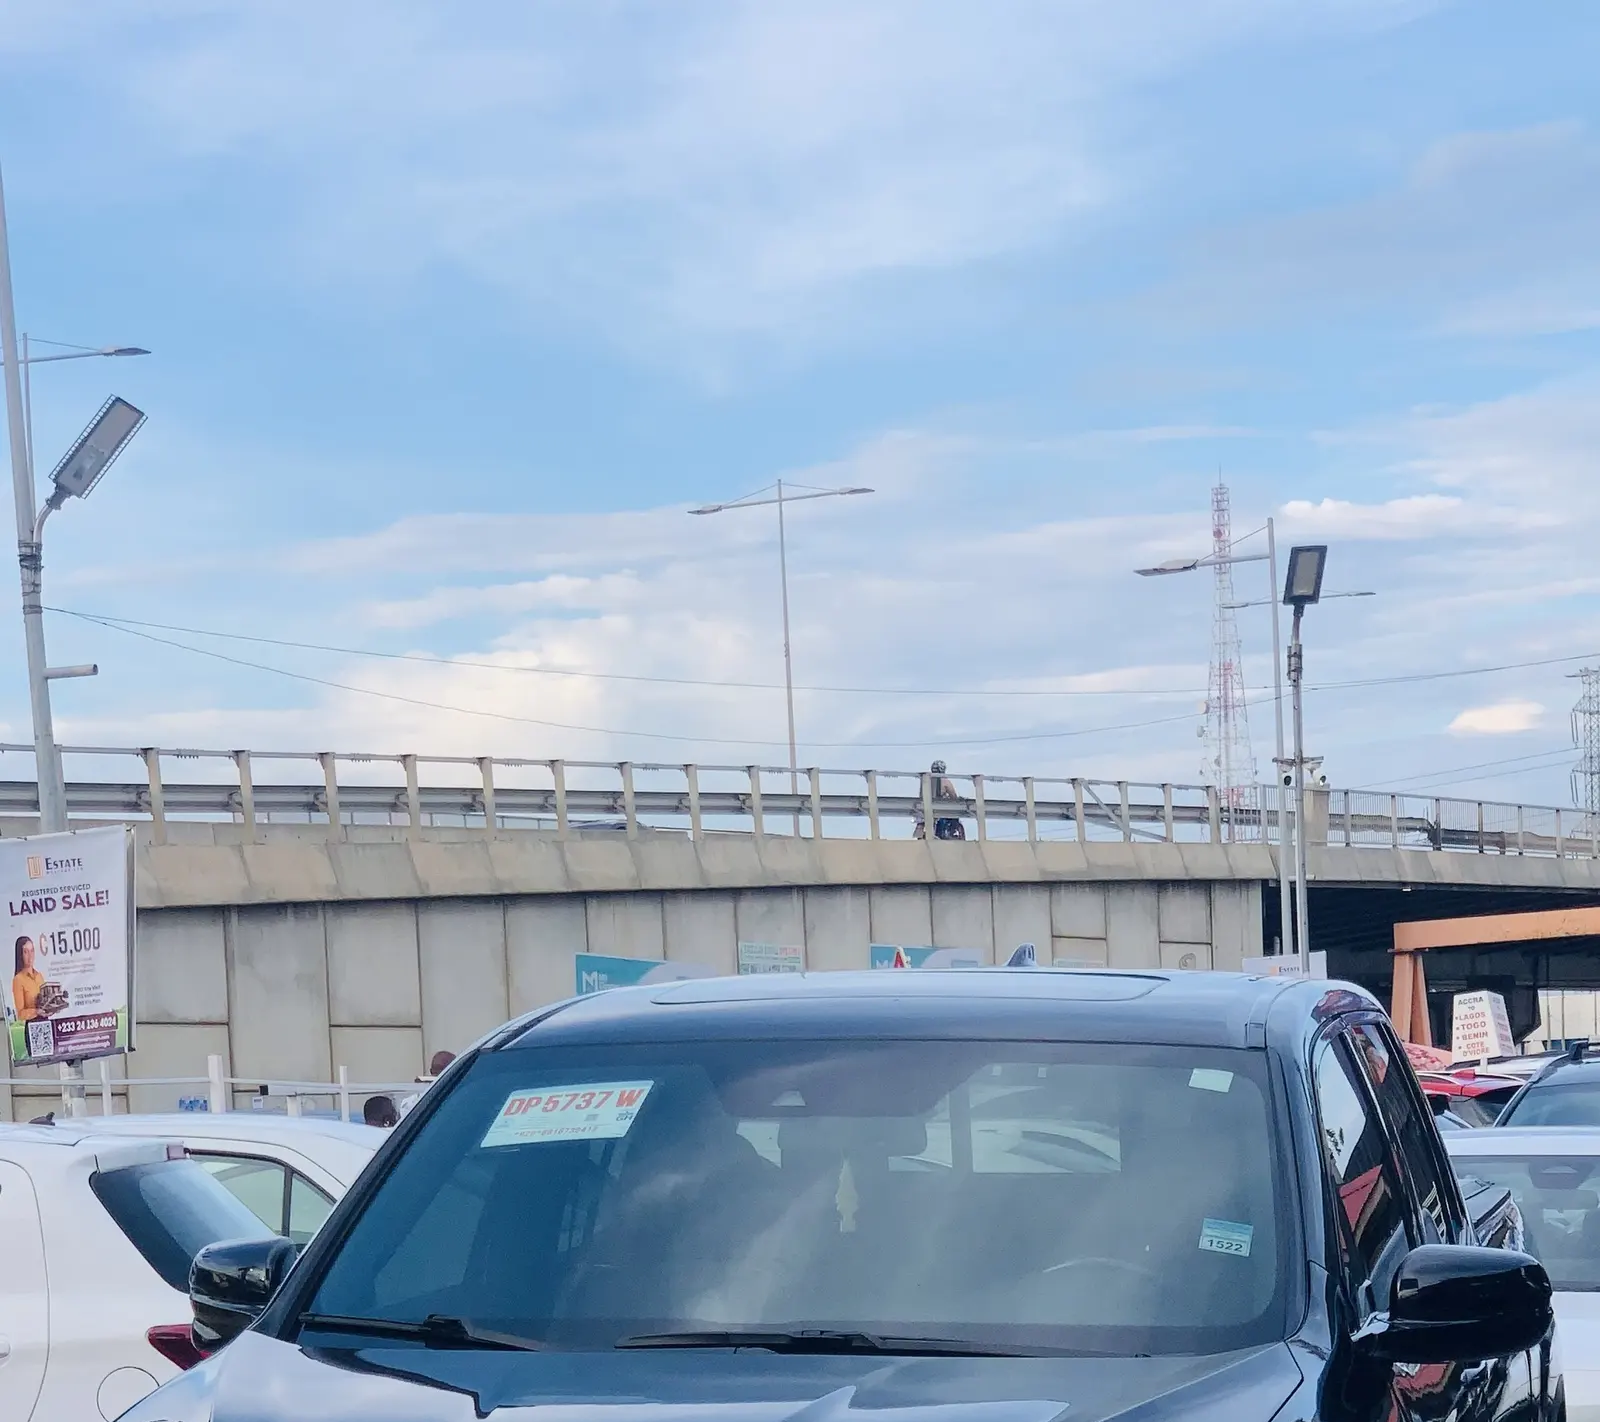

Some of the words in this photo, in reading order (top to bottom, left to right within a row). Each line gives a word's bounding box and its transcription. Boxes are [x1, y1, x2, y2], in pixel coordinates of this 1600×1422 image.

[21, 887, 59, 897] REGISTERED
[60, 883, 91, 893] SERVICED
[9, 897, 57, 917] LAND
[61, 889, 110, 910] SALE!
[1458, 996, 1484, 1005] ACCRA
[1459, 1012, 1486, 1020] LAGOS
[57, 1021, 76, 1033] +233
[76, 1020, 86, 1030] 24
[1461, 1021, 1487, 1030] TOGO
[1462, 1031, 1488, 1040] BENIN
[503, 1096, 543, 1117] DP
[541, 1090, 615, 1113] 5737
[615, 1088, 645, 1108] W
[1207, 1239, 1243, 1252] 1522
